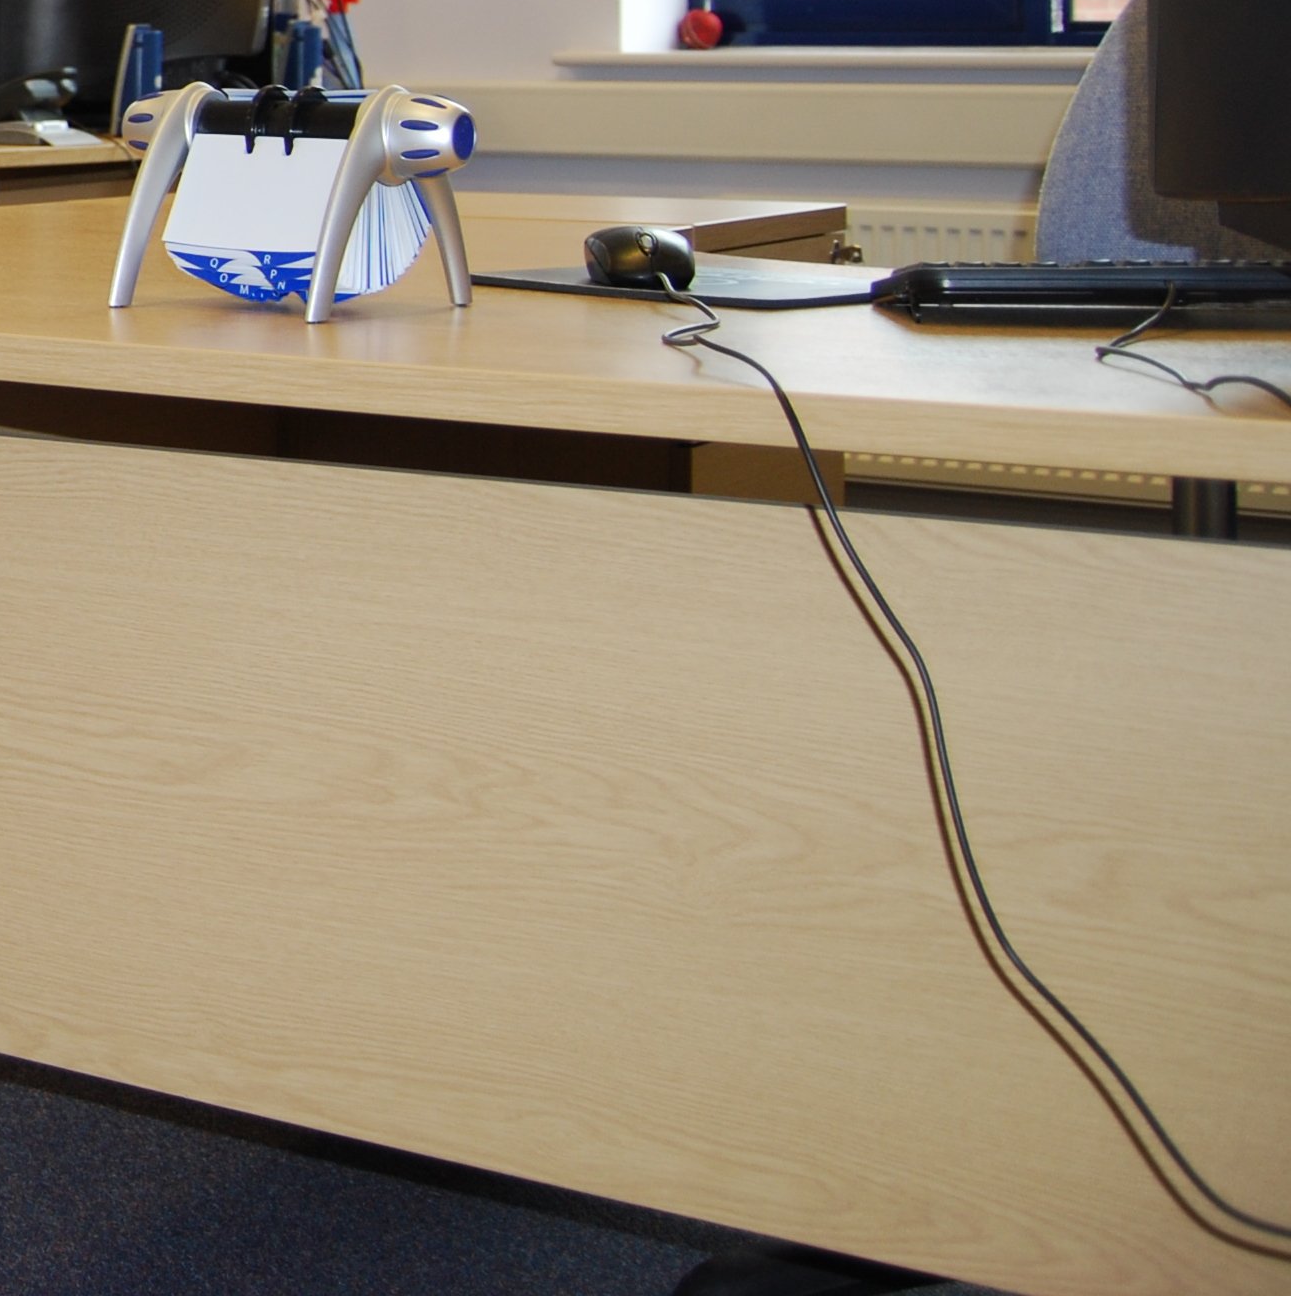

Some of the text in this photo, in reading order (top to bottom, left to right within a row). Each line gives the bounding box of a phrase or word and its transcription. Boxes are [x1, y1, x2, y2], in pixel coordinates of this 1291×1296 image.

[209, 257, 219, 269] Q
[263, 254, 272, 265] R
[219, 272, 229, 283] O
[269, 268, 278, 280] P
[239, 284, 249, 295] M
[277, 280, 286, 291] N
